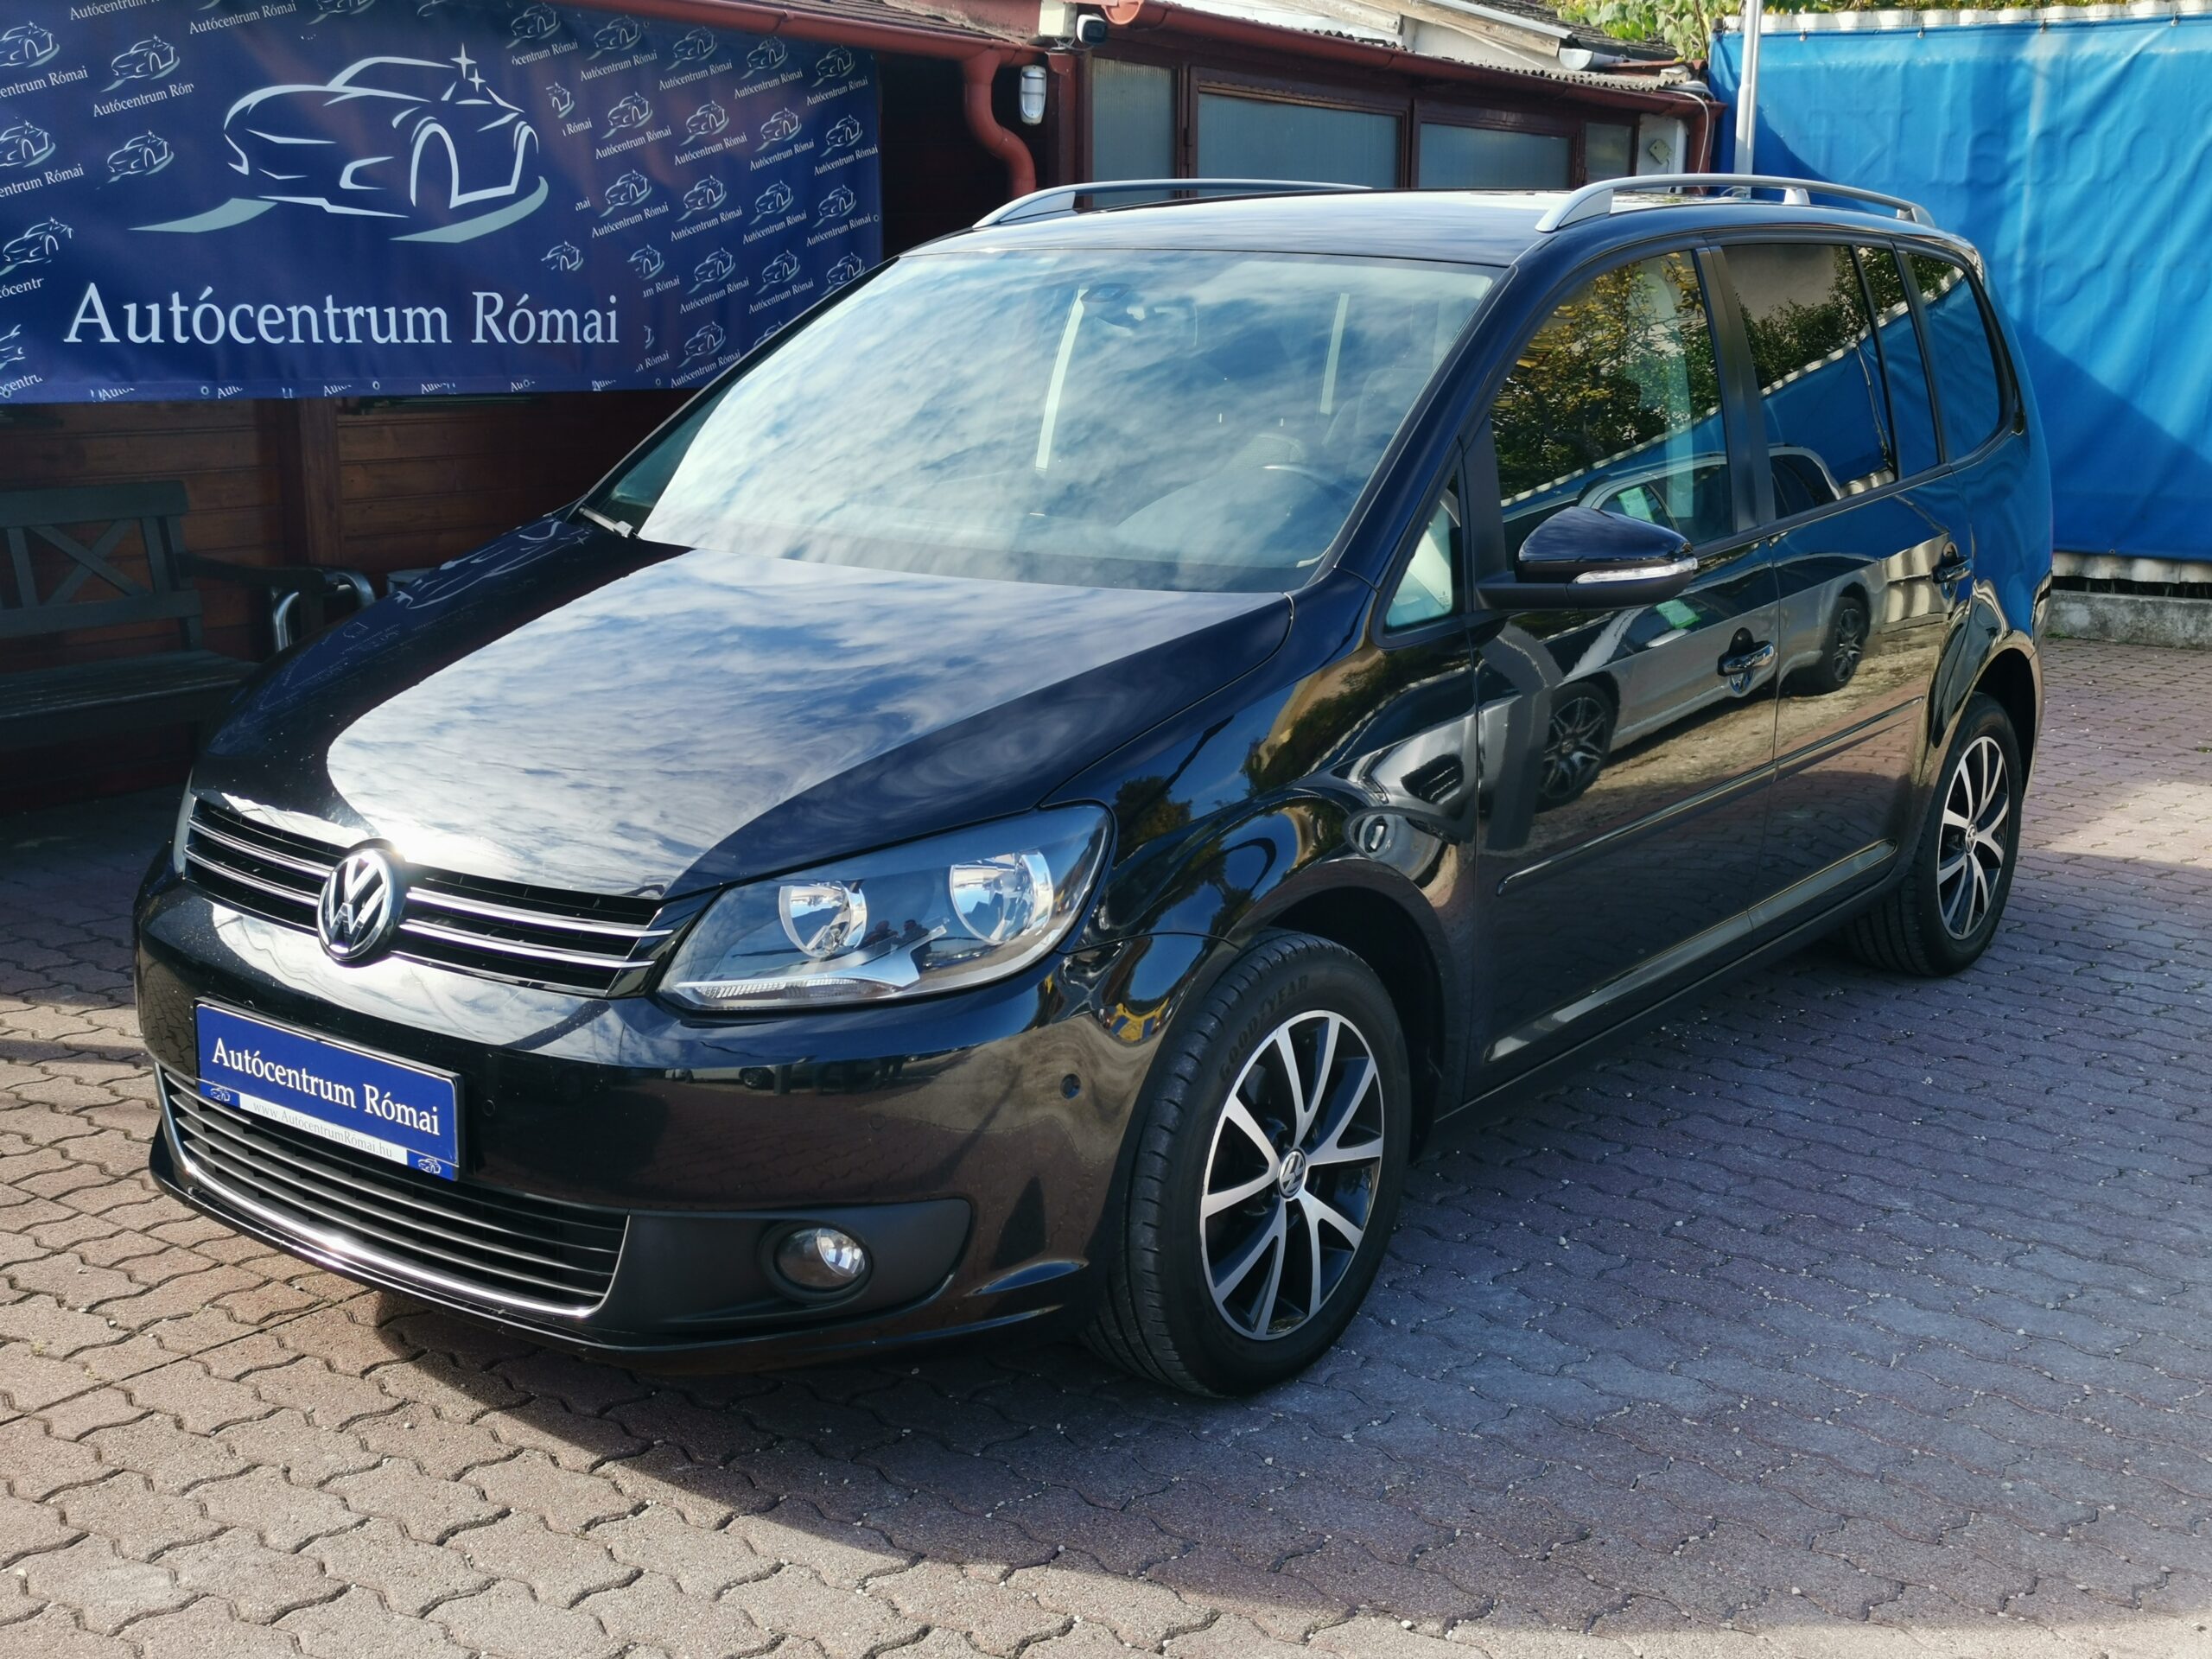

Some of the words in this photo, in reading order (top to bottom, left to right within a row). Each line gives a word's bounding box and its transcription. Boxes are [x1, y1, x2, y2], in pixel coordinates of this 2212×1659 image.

[189, 10, 260, 35] Autócentrum
[262, 2, 297, 19] Római
[552, 39, 578, 55] Római
[48, 65, 88, 86] Római
[581, 60, 632, 81] Autócentrum
[633, 49, 658, 67] Római
[658, 70, 709, 91] Autócentrum
[709, 59, 733, 75] Római
[734, 79, 779, 99] Autócentrum
[780, 68, 803, 84] Római
[806, 86, 848, 106] Autócentrum
[848, 76, 868, 92] Római
[92, 90, 167, 118] Autócentrum
[566, 118, 593, 134] Római
[595, 134, 646, 160] Autócentrum
[646, 126, 671, 143] Római
[674, 143, 723, 166] Autócentrum
[723, 132, 747, 149] Római
[749, 149, 792, 172] Autócentrum
[793, 138, 814, 156] Római
[44, 163, 84, 185] Római
[814, 155, 855, 176] Autócentrum
[855, 144, 878, 161] Római
[592, 213, 643, 238] Autócentrum
[644, 201, 669, 219] Római
[671, 219, 719, 242] Autócentrum
[719, 206, 742, 223] Római
[743, 222, 785, 245] Autócentrum
[785, 211, 807, 226] Római
[806, 225, 849, 247] Autócentrum
[849, 213, 871, 227] Római
[655, 275, 680, 293] Római
[680, 291, 726, 314] Autócentrum
[726, 276, 749, 294] Római
[748, 292, 791, 315] Autócentrum
[791, 279, 814, 295] Római
[63, 282, 452, 345] Autócentrum
[471, 291, 620, 345] Római
[645, 350, 670, 368] Római
[671, 362, 717, 388] Autócentrum
[717, 348, 741, 366] Római
[212, 1037, 356, 1109] Autócentrum
[364, 1083, 440, 1135] Római
[253, 1102, 392, 1158] www.AutócentrumRómai.hu
